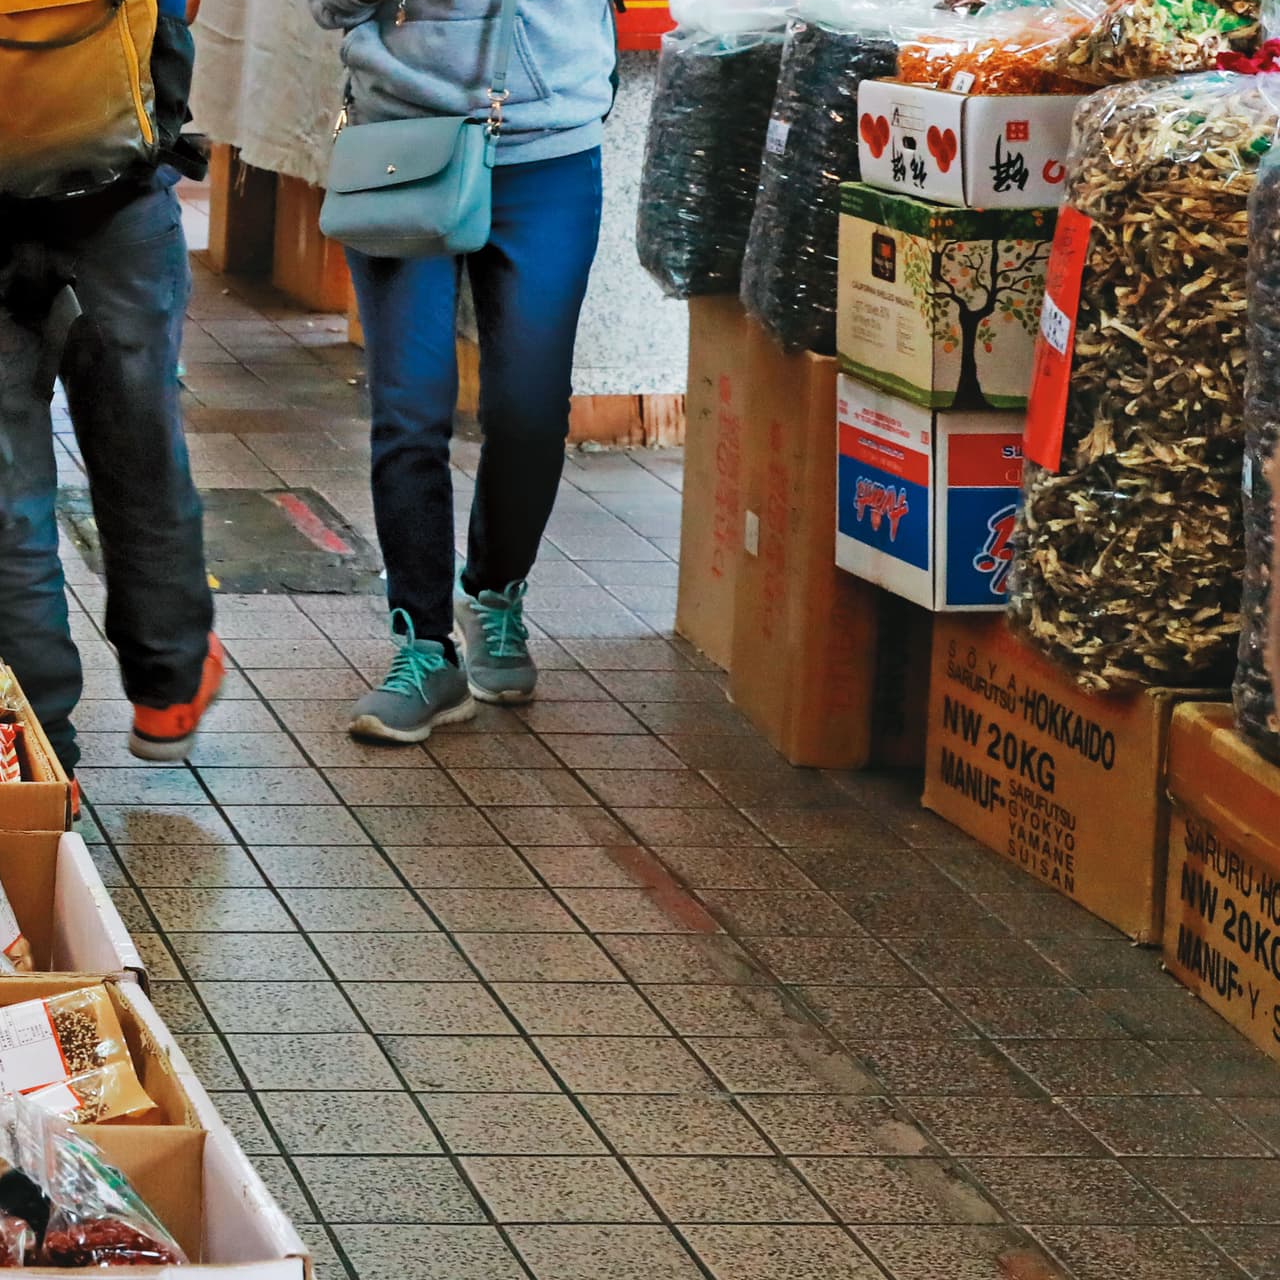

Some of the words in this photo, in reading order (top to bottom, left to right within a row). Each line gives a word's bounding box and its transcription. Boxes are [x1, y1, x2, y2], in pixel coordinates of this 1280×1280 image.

[947, 661, 1017, 714] SARUFUTSU
[943, 694, 982, 747] NW
[986, 723, 1056, 795] 20KG
[1007, 819, 1075, 874] YAMANE
[1007, 839, 1075, 894] SUISAN
[1180, 860, 1219, 925] NW
